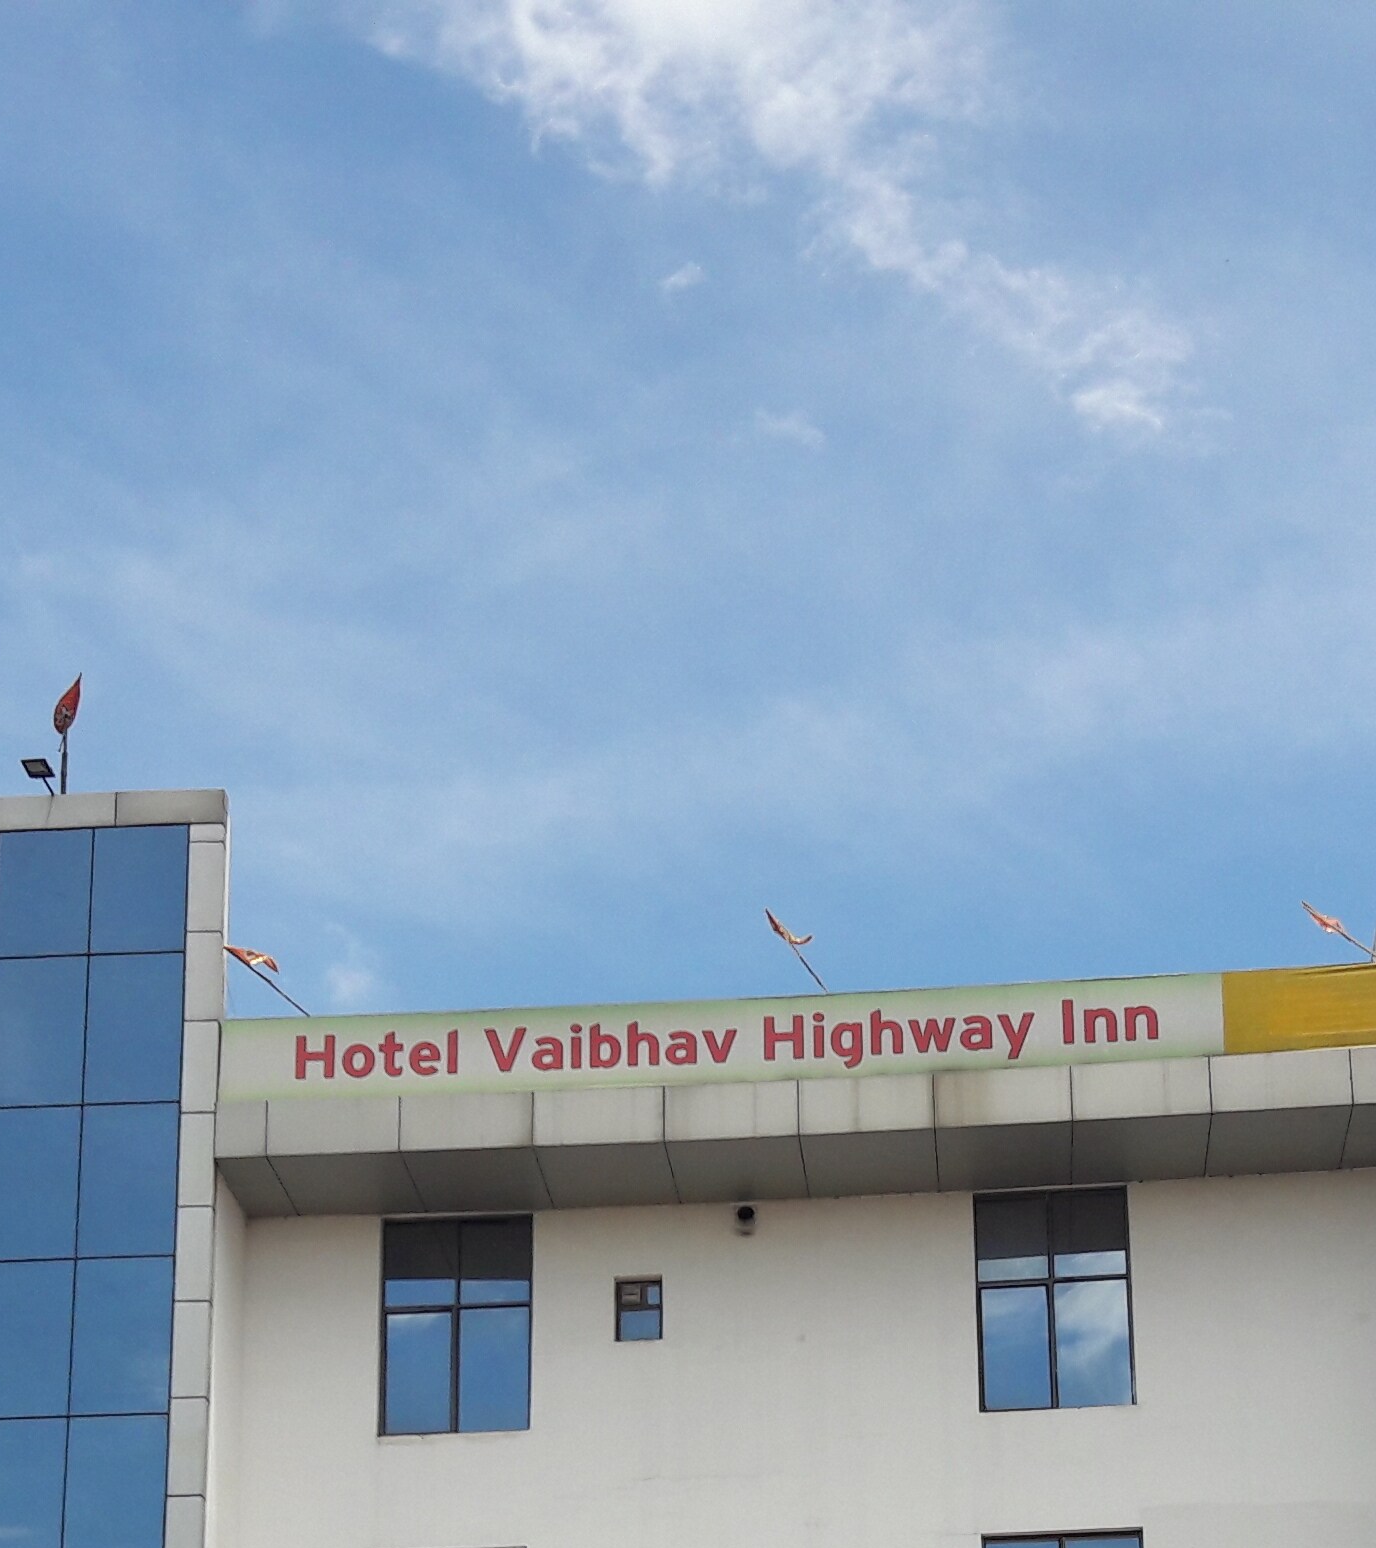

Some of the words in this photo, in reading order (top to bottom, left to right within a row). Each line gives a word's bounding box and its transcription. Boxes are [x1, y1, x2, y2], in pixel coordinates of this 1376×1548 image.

[295, 1029, 458, 1080] Hotel
[484, 1021, 738, 1072] Vaibhav
[763, 1008, 1035, 1069] Highway
[1061, 998, 1160, 1045] Inn
